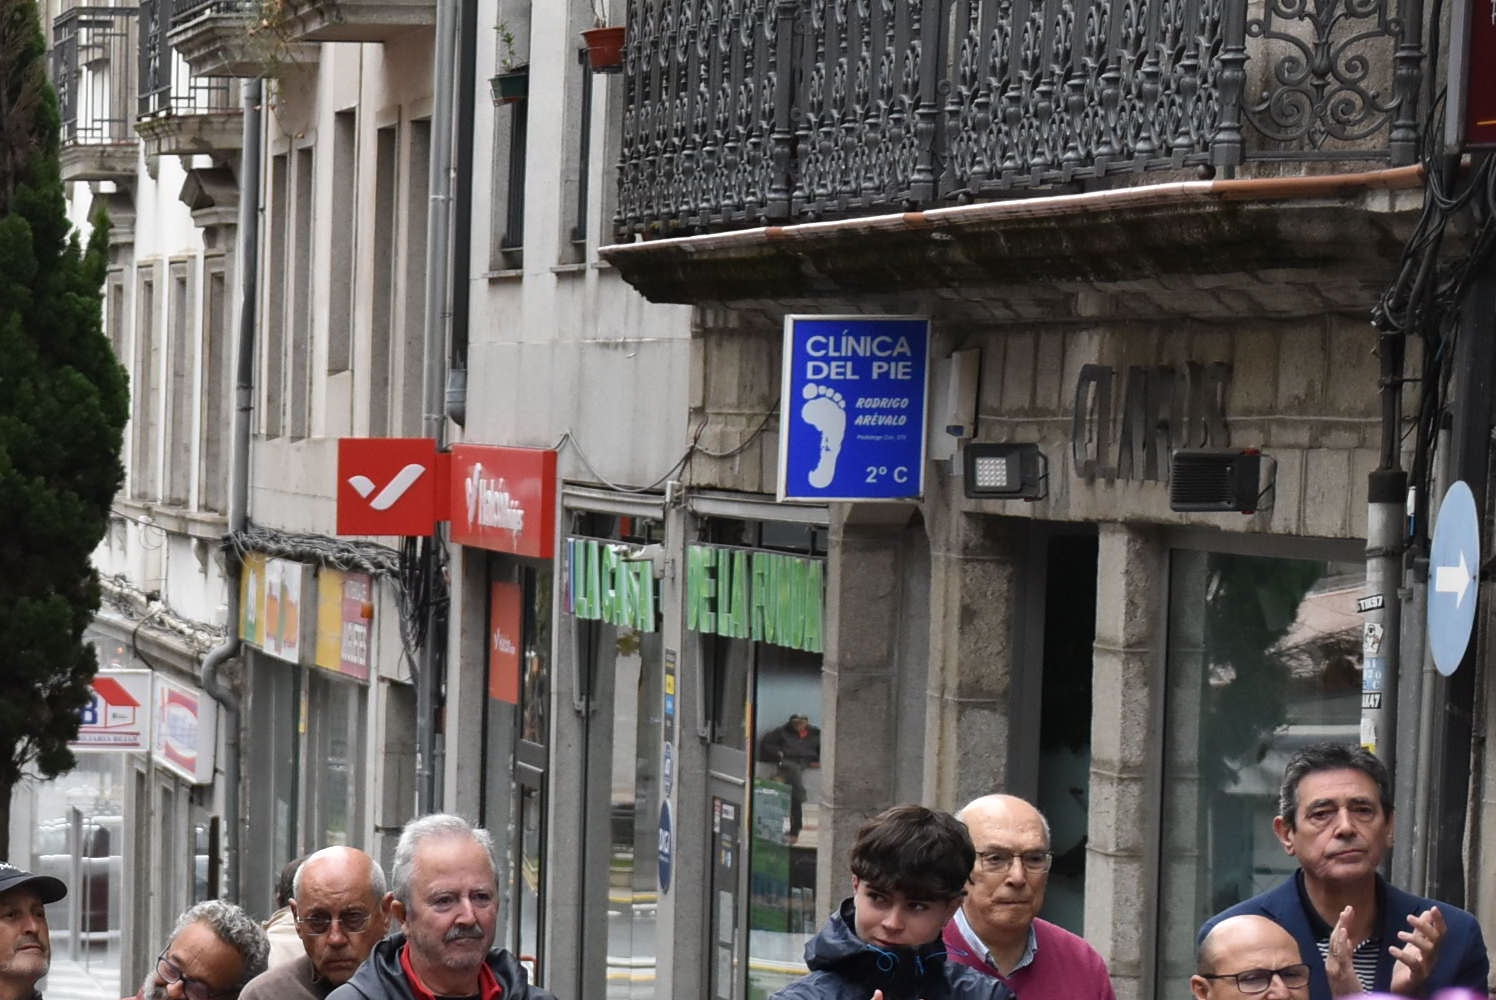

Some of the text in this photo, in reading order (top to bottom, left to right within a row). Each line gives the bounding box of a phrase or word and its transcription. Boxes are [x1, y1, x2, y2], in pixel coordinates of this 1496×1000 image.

[806, 329, 912, 358] CLÍNICA
[806, 361, 913, 380] DEL PIE
[855, 397, 909, 409] RODRIGO
[865, 465, 909, 484] 2º C
